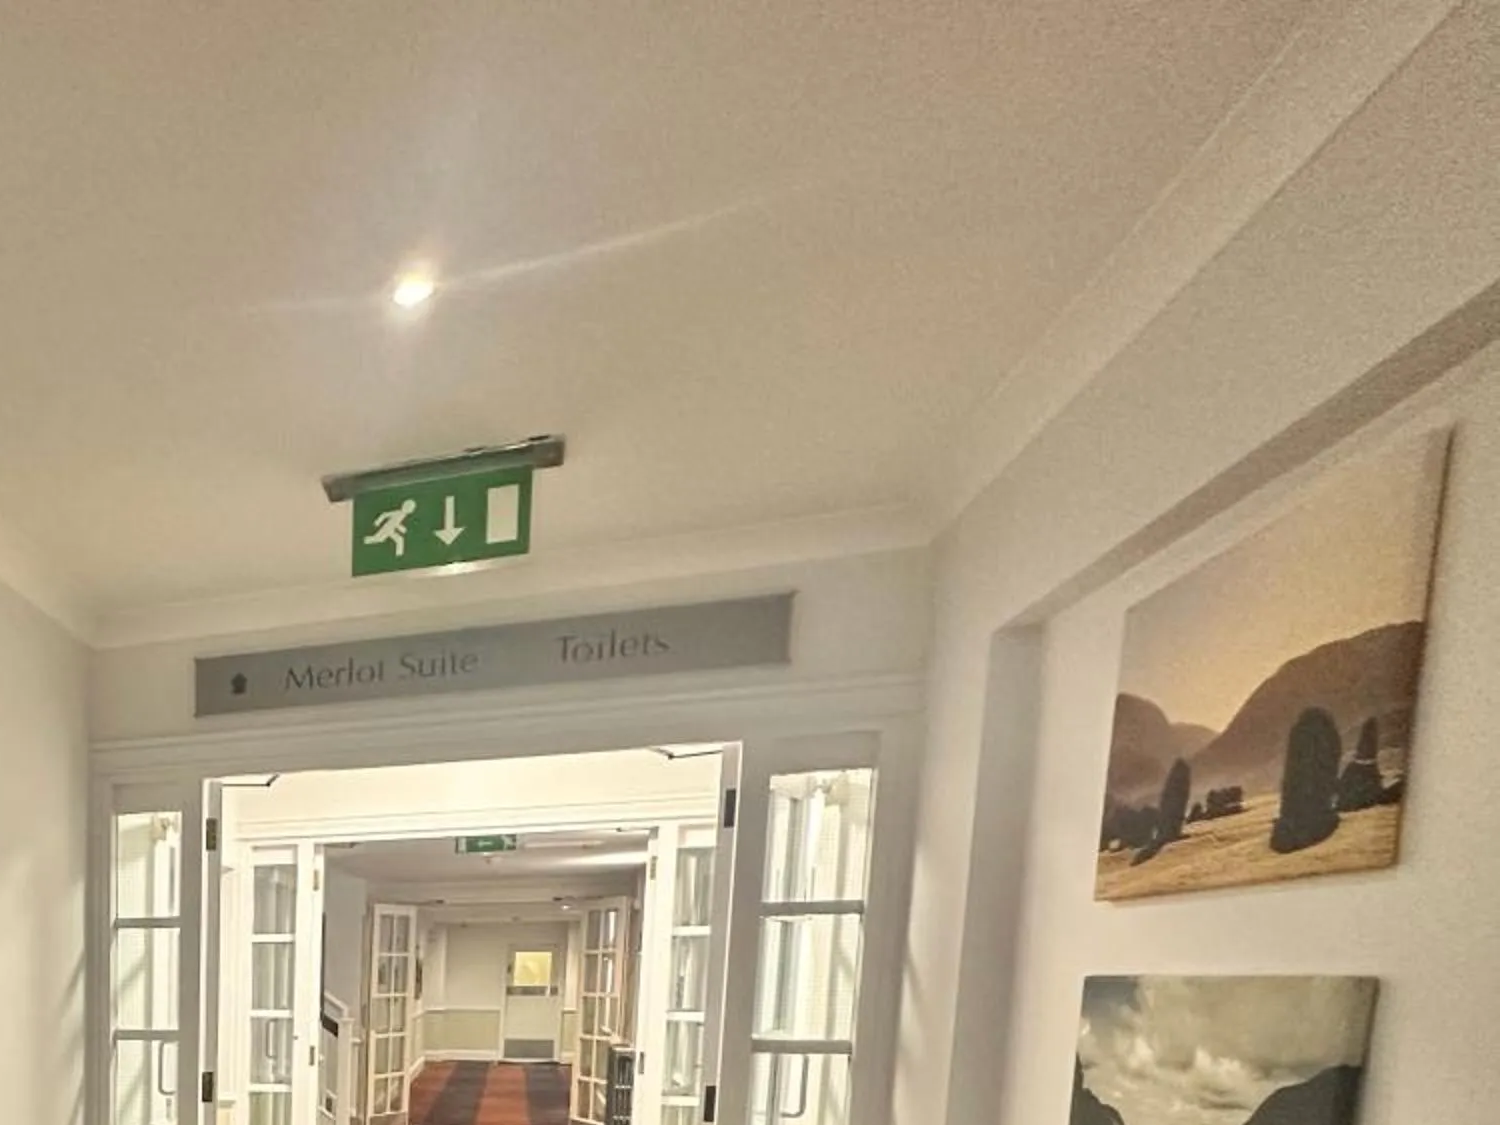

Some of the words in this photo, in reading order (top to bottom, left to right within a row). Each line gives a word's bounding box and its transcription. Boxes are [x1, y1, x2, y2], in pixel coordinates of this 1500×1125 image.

[554, 628, 671, 663] Toilets
[281, 656, 384, 690] Merlot
[398, 650, 479, 681] Suite
